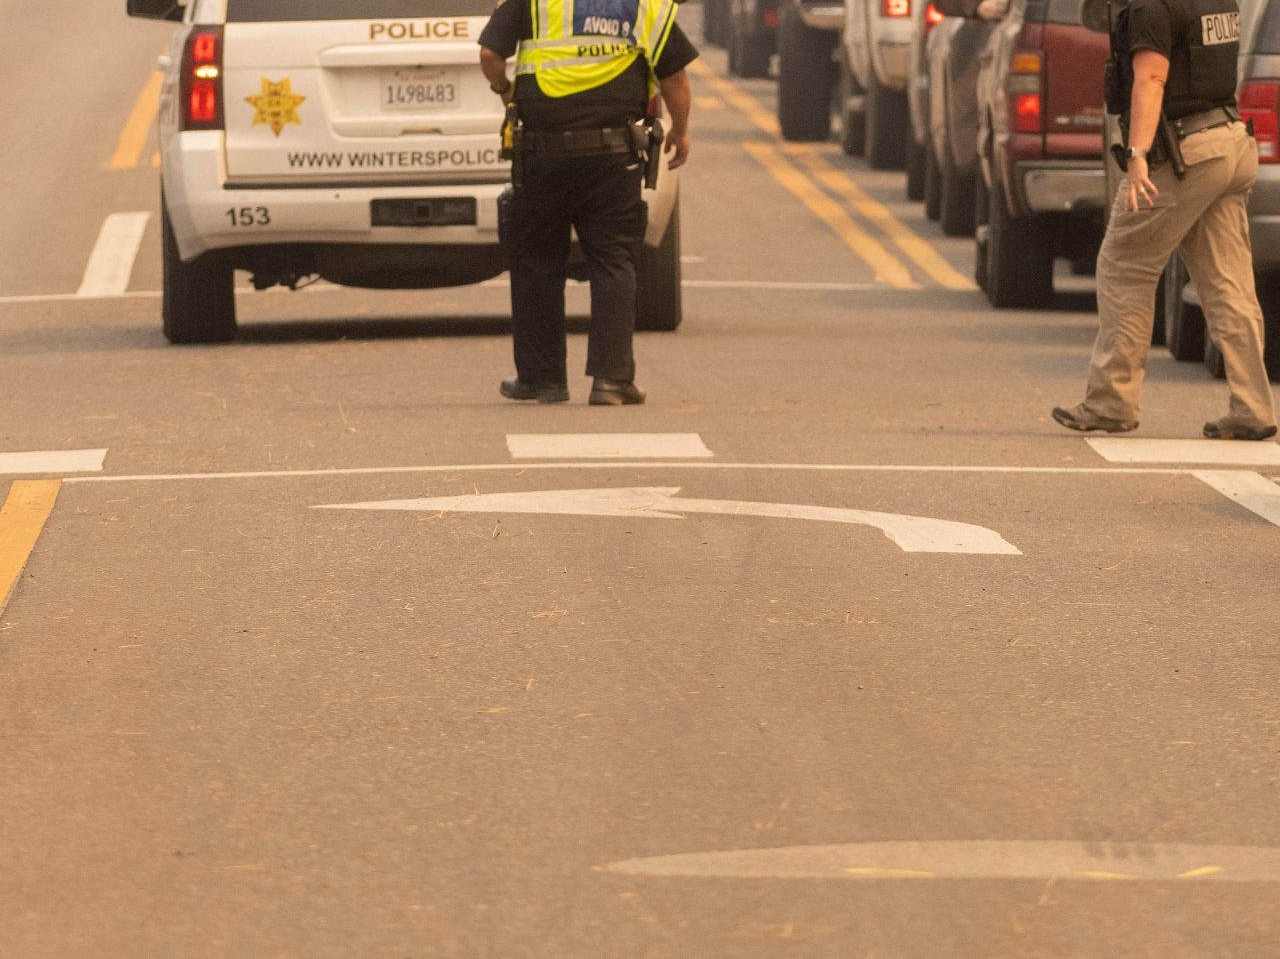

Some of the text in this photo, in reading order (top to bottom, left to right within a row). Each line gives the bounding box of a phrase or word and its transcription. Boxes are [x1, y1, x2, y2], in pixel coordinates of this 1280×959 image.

[370, 22, 469, 39] POLICE
[583, 16, 620, 36] AVOID
[1206, 13, 1240, 41] POLICE
[387, 84, 455, 103] 1498483
[226, 206, 271, 227] 153
